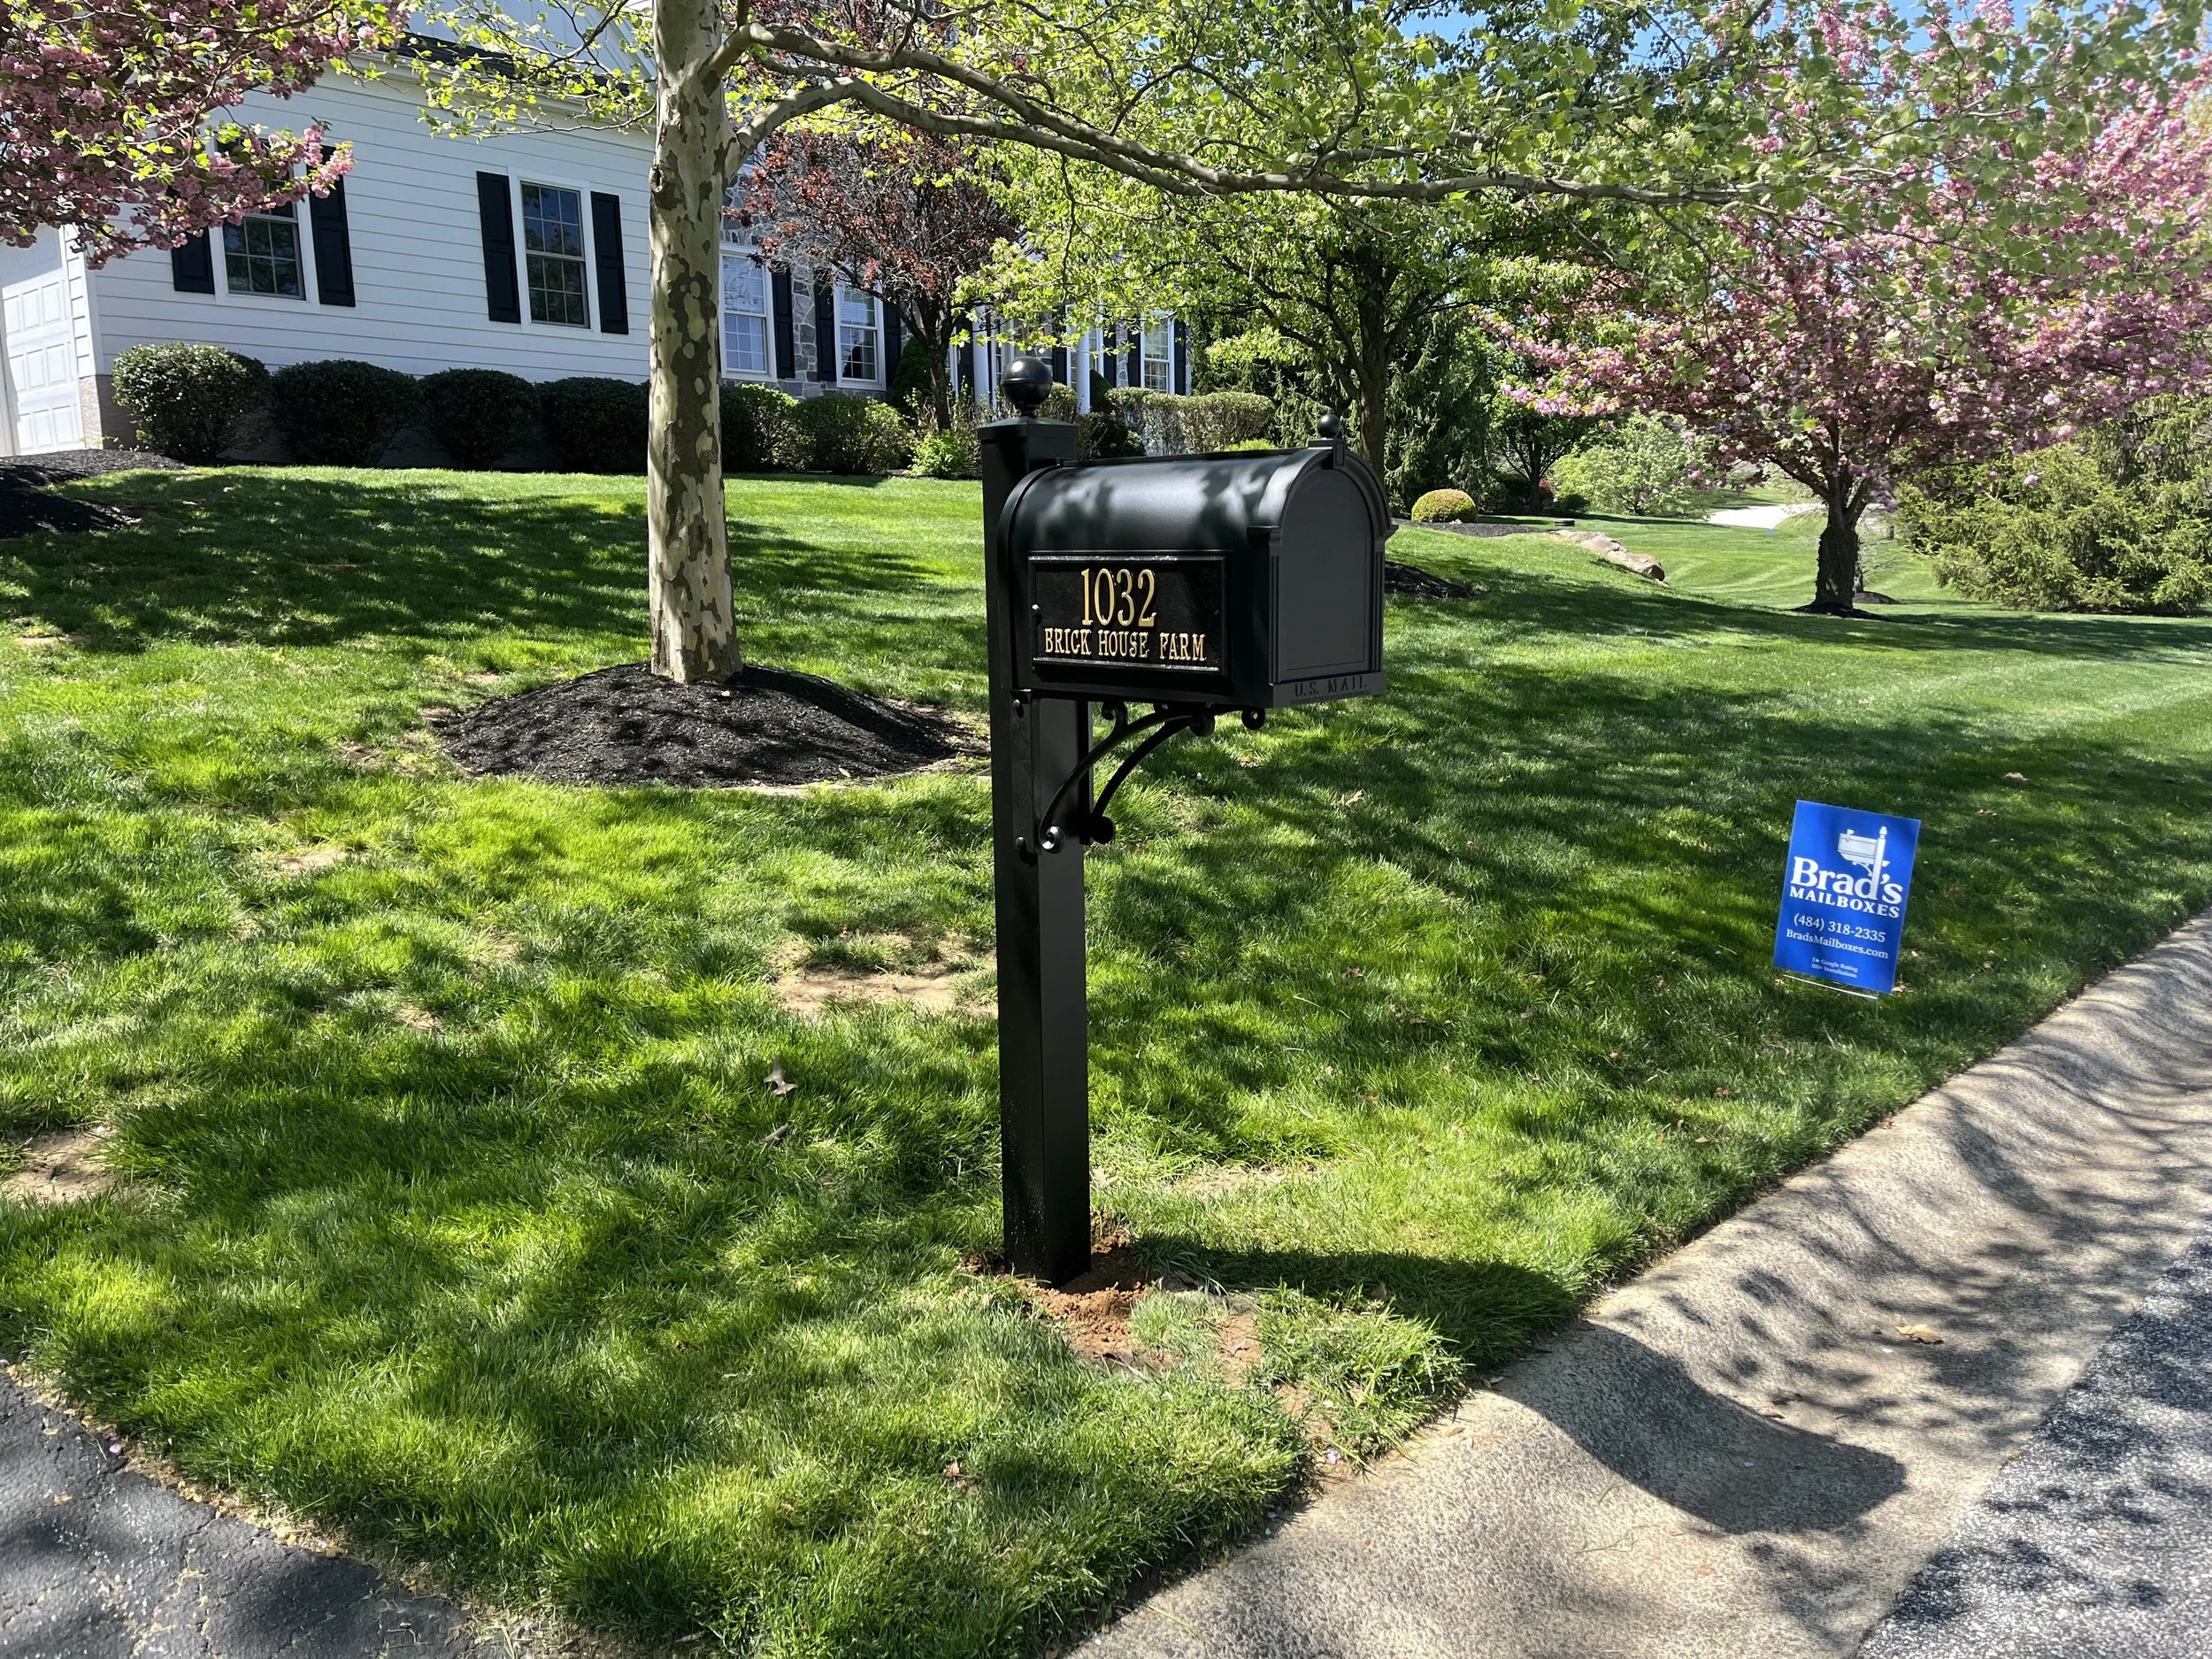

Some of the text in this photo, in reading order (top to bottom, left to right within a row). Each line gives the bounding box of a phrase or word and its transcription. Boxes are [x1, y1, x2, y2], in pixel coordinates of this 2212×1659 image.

[1081, 568, 1156, 626] 1032
[1045, 628, 1207, 662] BRICK HOUSE FARM
[1294, 675, 1367, 697] U.S. MAIL
[1790, 856, 1902, 905] Brad's
[1789, 886, 1900, 918] MAILBOXES
[1786, 928, 1889, 959] BradsMailboxes.com
[1793, 912, 1886, 943] (484) 318-2335
